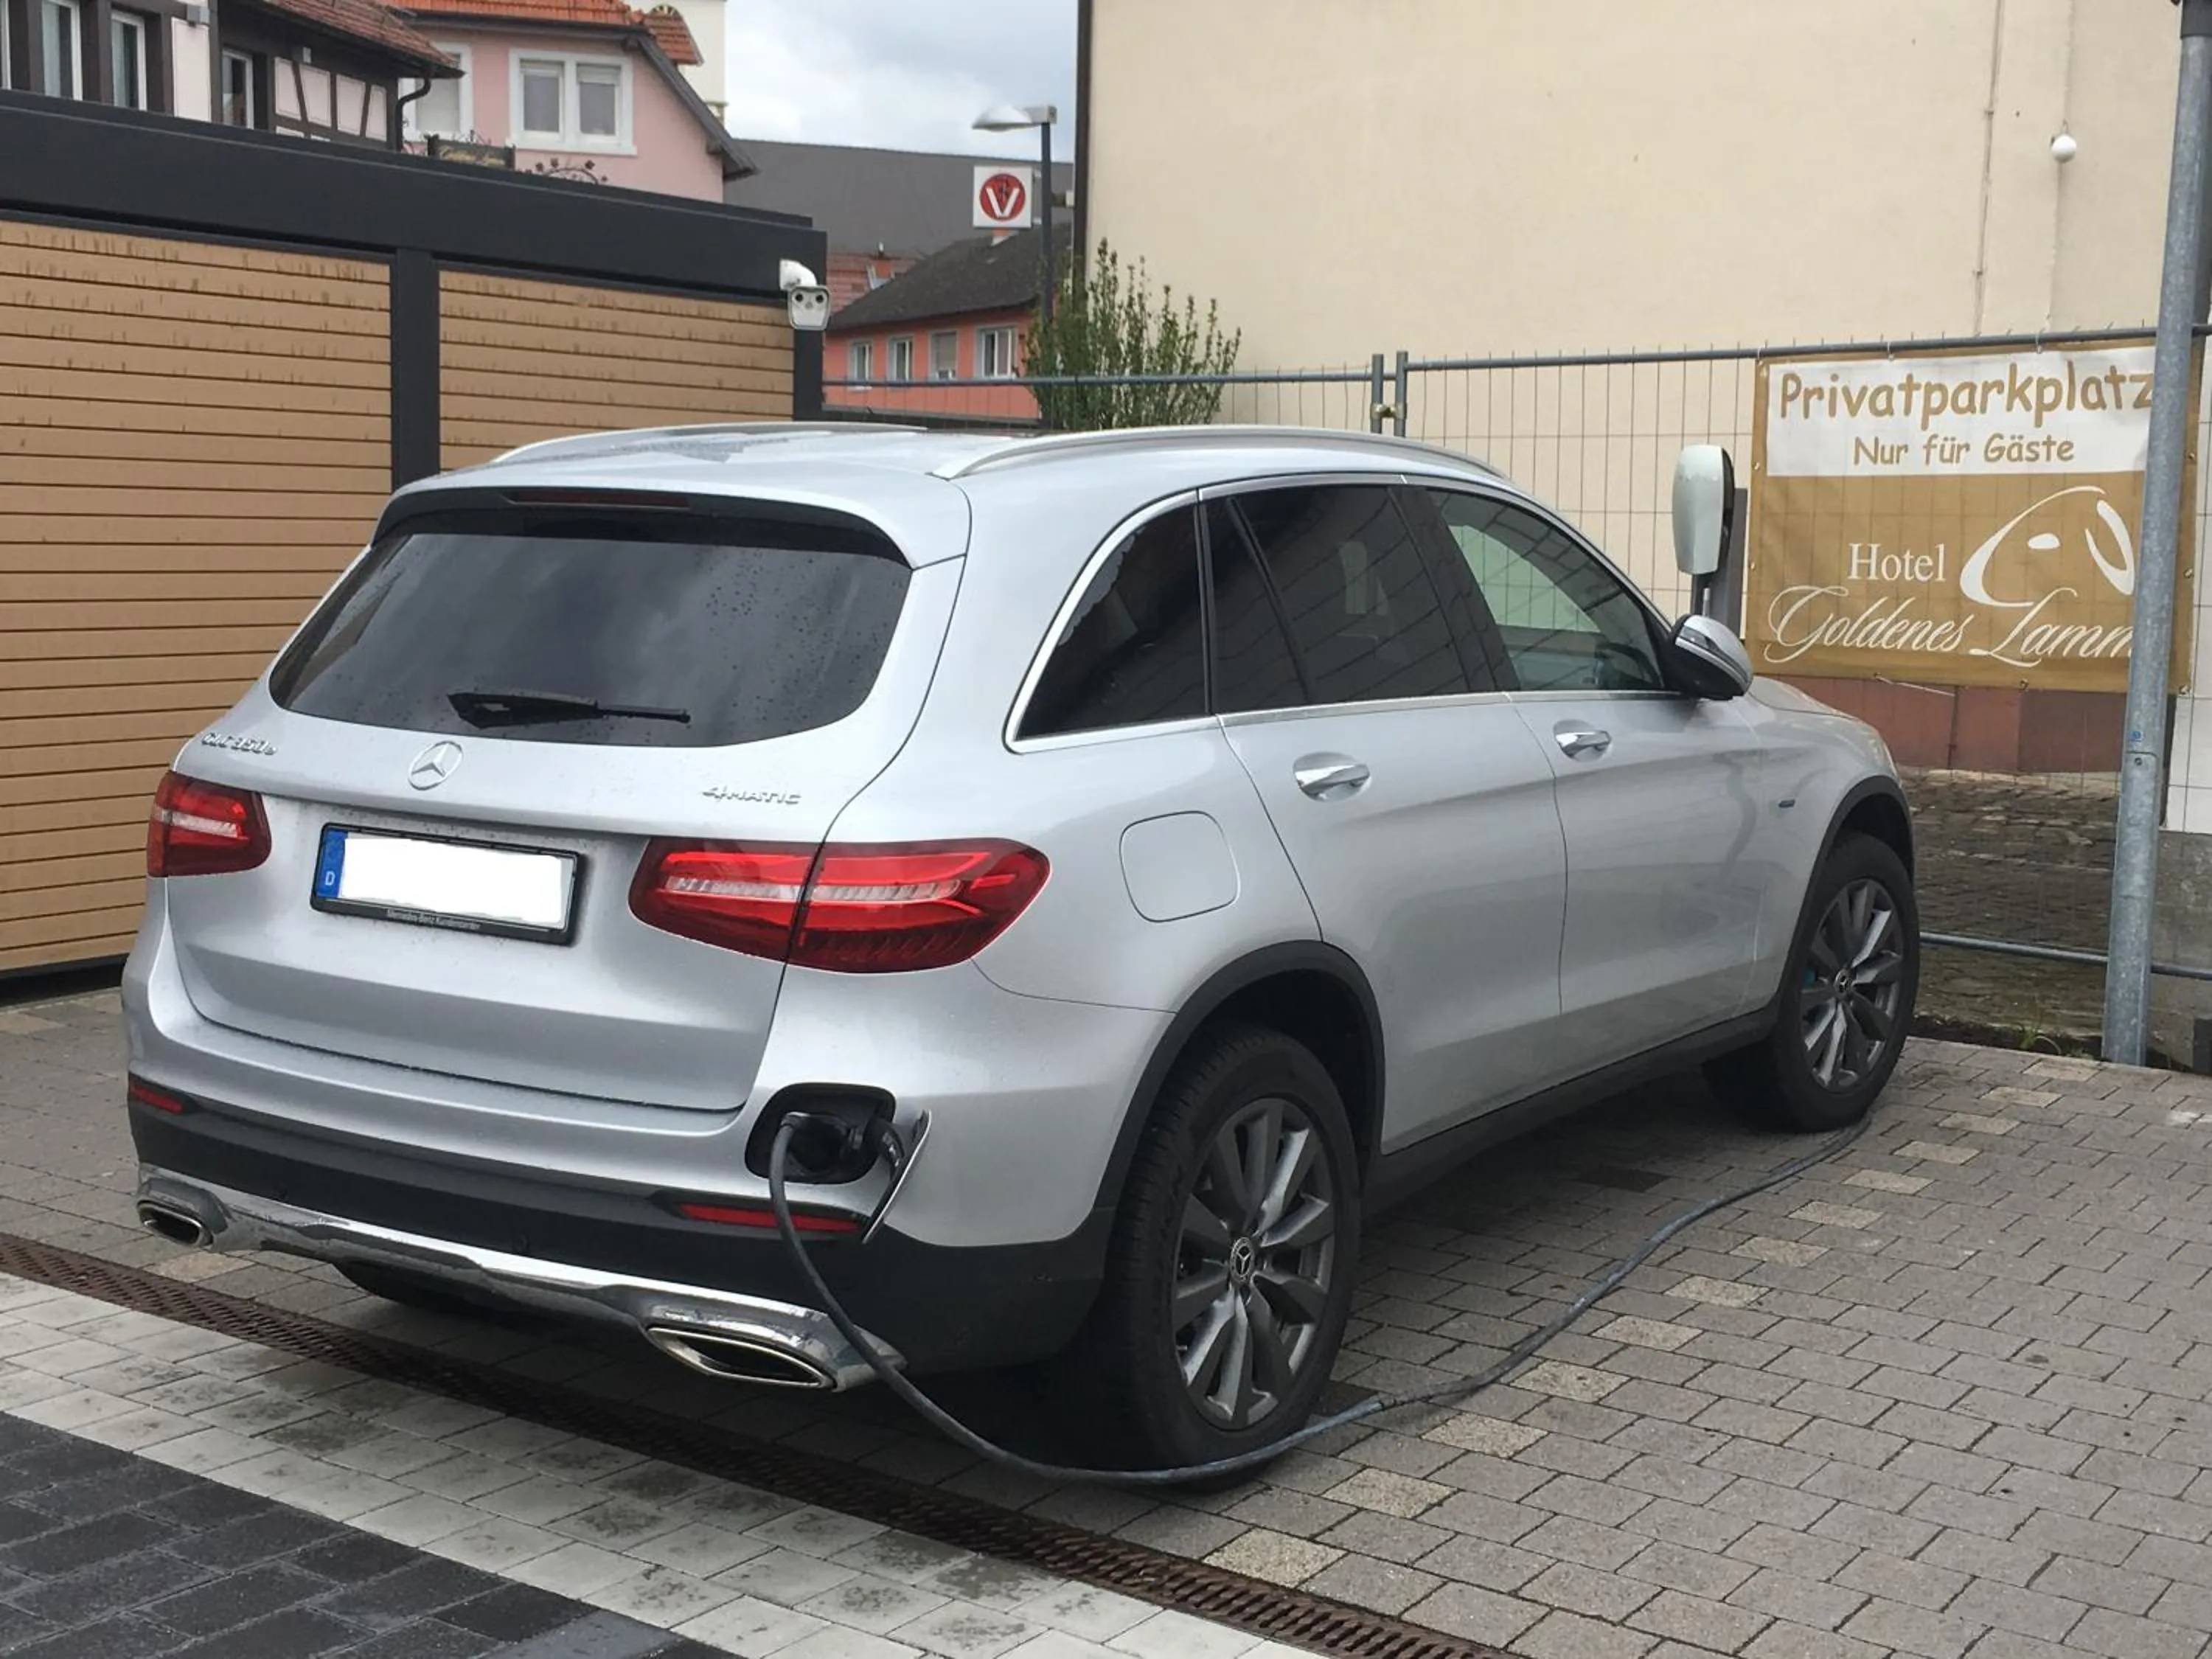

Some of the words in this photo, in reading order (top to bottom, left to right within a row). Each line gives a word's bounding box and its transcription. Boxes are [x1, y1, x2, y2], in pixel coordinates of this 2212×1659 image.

[1780, 361, 2154, 430] Privatparkplatz
[1854, 436, 1908, 465] Nur
[1922, 434, 1970, 465] für
[1983, 433, 2074, 462] Gäste
[1848, 543, 1946, 581] Hotel
[1763, 585, 1975, 662] Goldenes
[702, 785, 801, 804] 4MATIC
[325, 871, 335, 886] D
